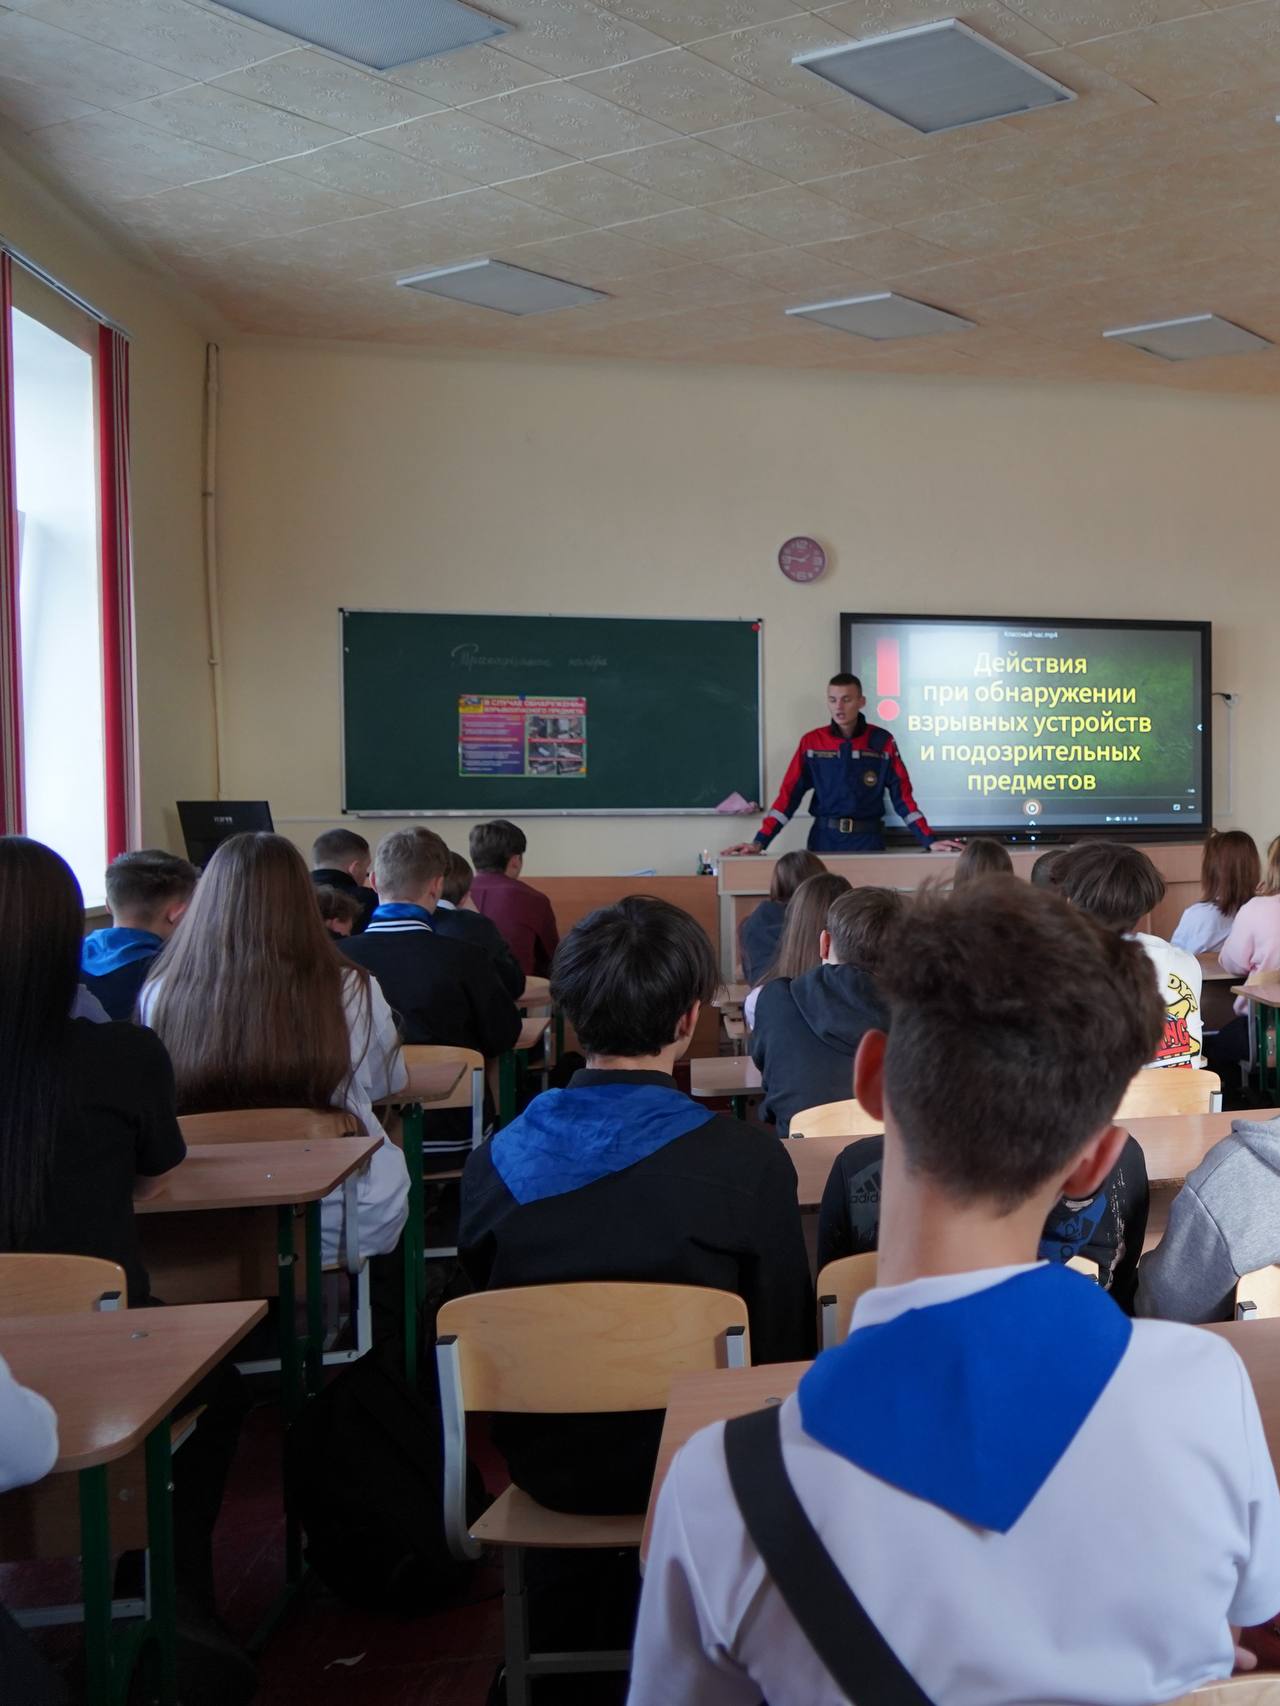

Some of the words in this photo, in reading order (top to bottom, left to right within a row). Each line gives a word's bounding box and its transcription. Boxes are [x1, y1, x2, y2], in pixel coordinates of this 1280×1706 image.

[973, 651, 1087, 676] Действия
[923, 685, 968, 707] при
[975, 680, 1137, 708] обнаружении
[908, 713, 1028, 736] взрывных
[1033, 711, 1152, 738] устройств
[920, 746, 935, 761] и
[942, 743, 1142, 766] подозрительных
[967, 772, 1097, 795] предметов
